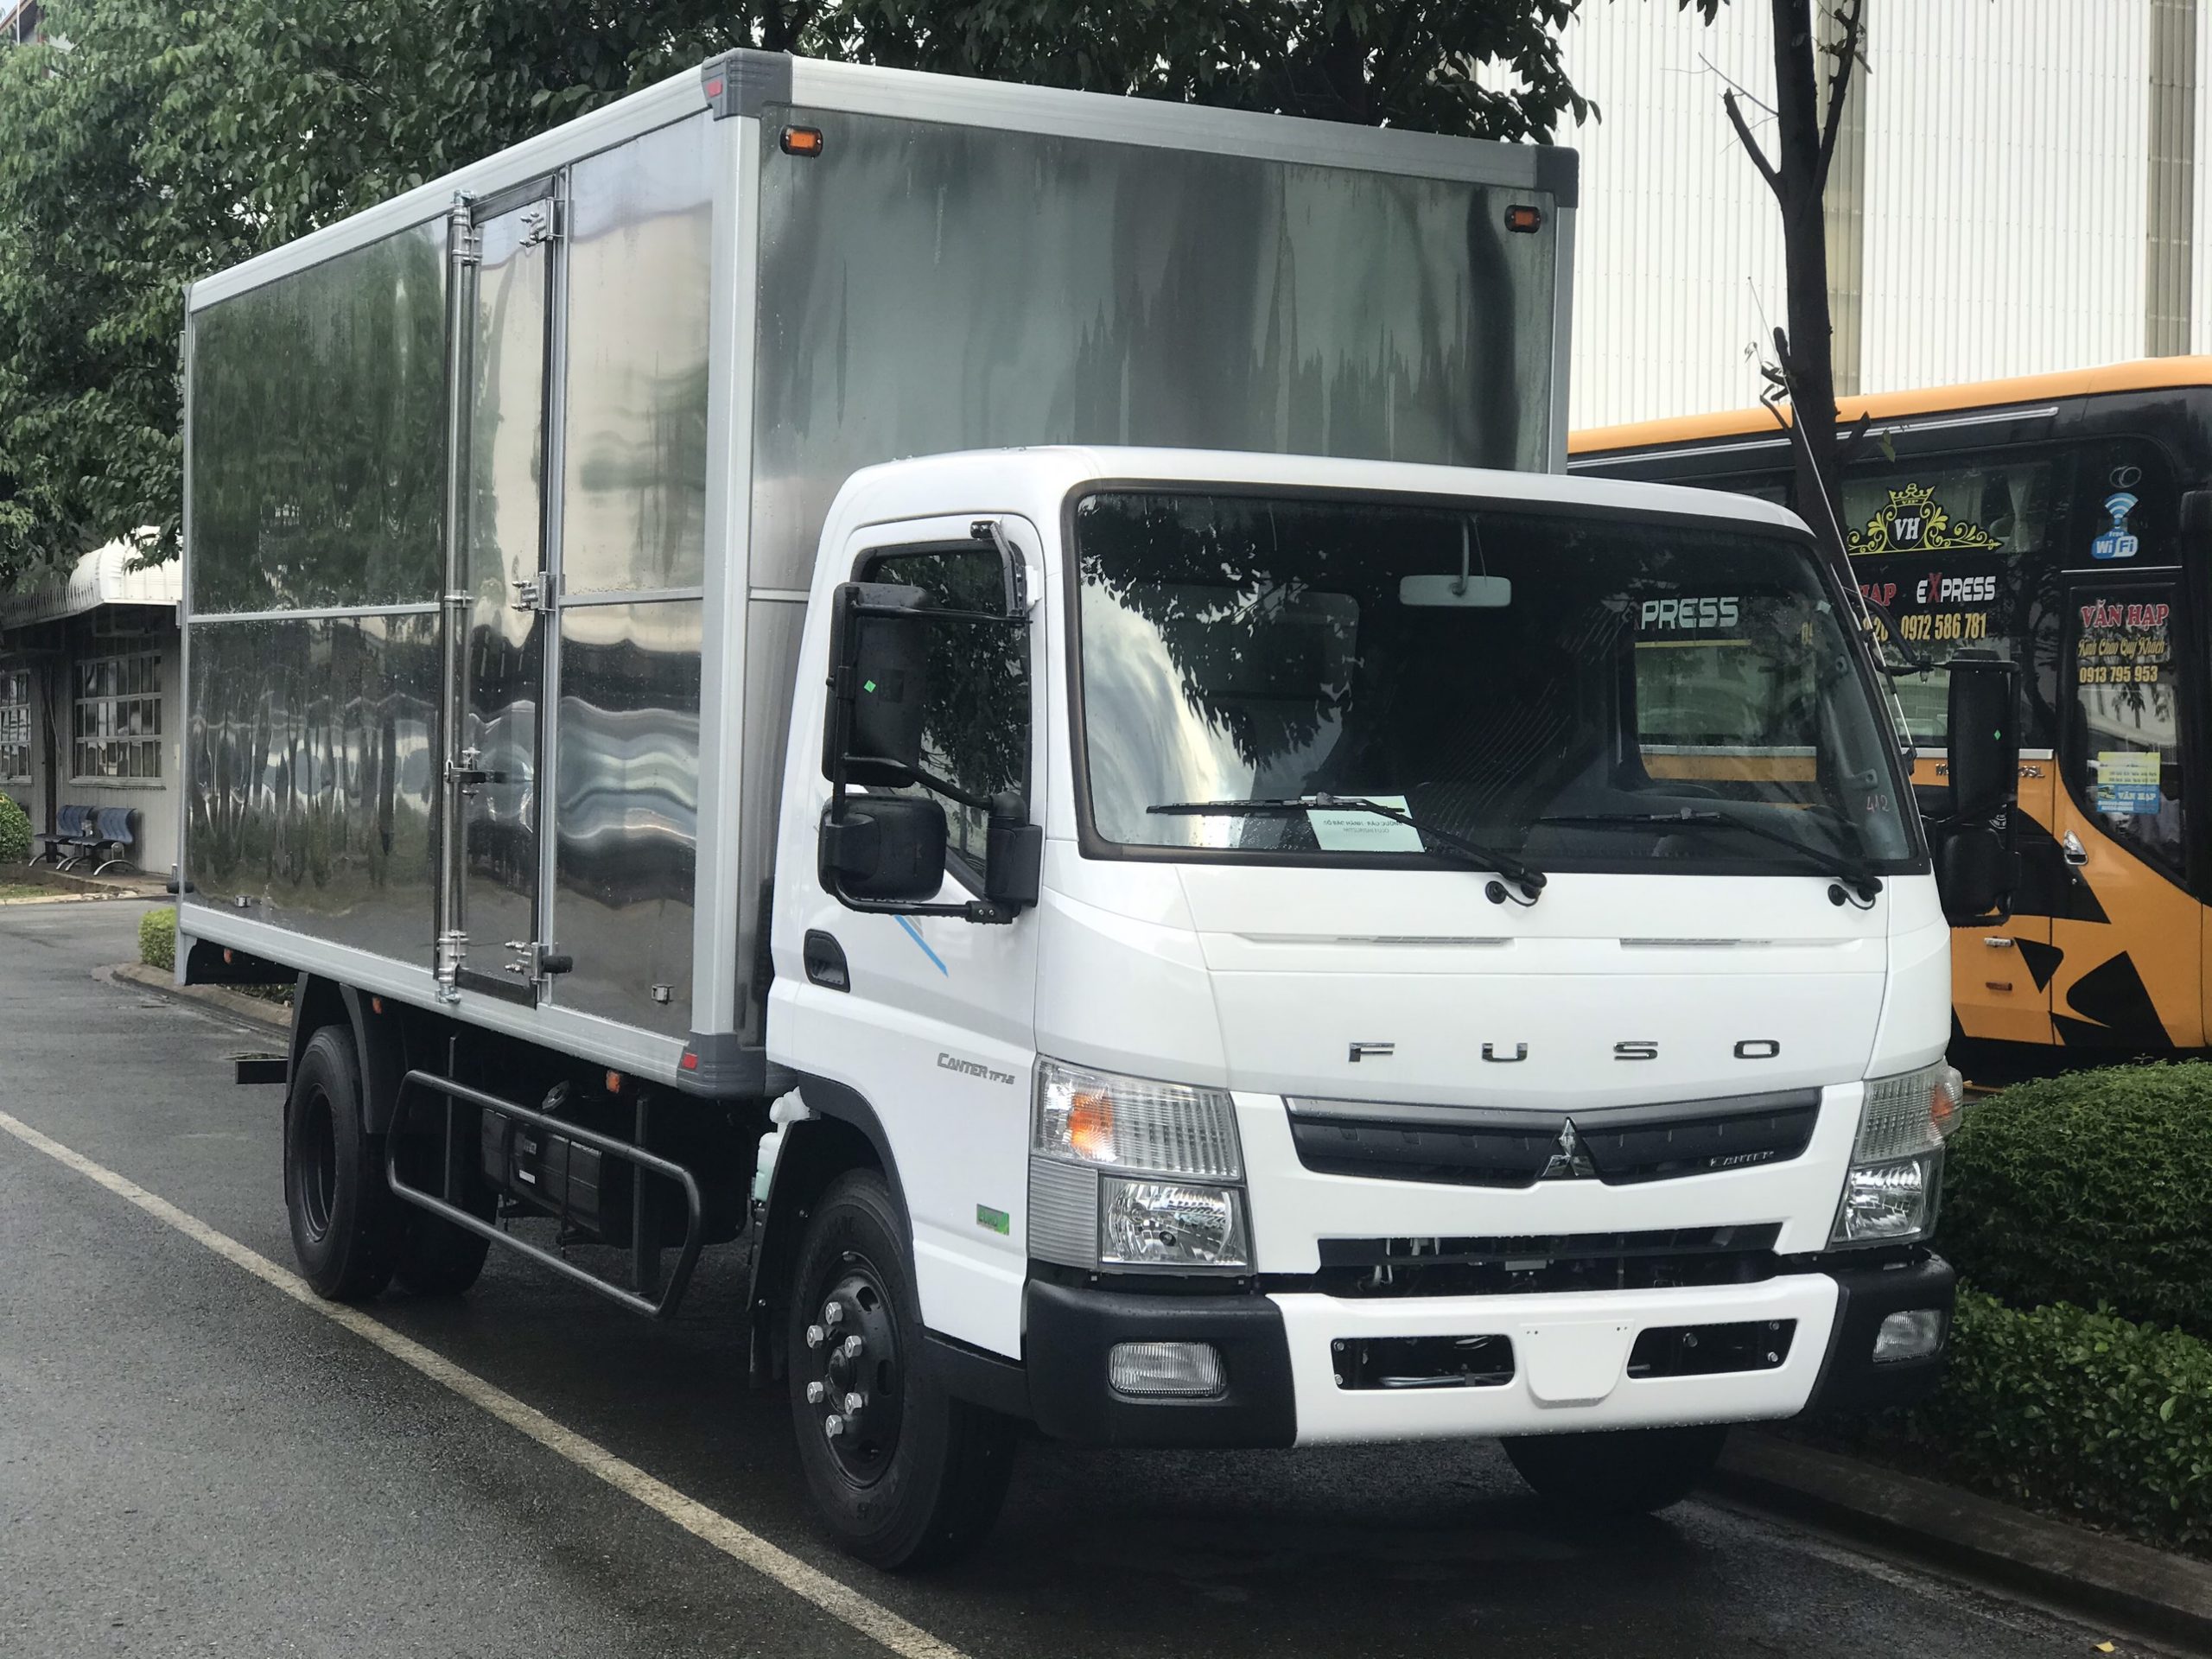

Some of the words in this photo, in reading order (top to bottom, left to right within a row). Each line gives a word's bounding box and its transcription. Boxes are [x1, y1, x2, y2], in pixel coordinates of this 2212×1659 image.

[1895, 518, 1920, 541] VH
[2081, 599, 2123, 628] VĂN
[1901, 615, 1931, 640] 0972
[1935, 613, 1961, 640] 586
[1965, 613, 1987, 639] 781
[2079, 666, 2107, 683] 0913
[2110, 665, 2131, 682] 795
[2134, 664, 2158, 682] 953
[1349, 1039, 1780, 1063] FUSO
